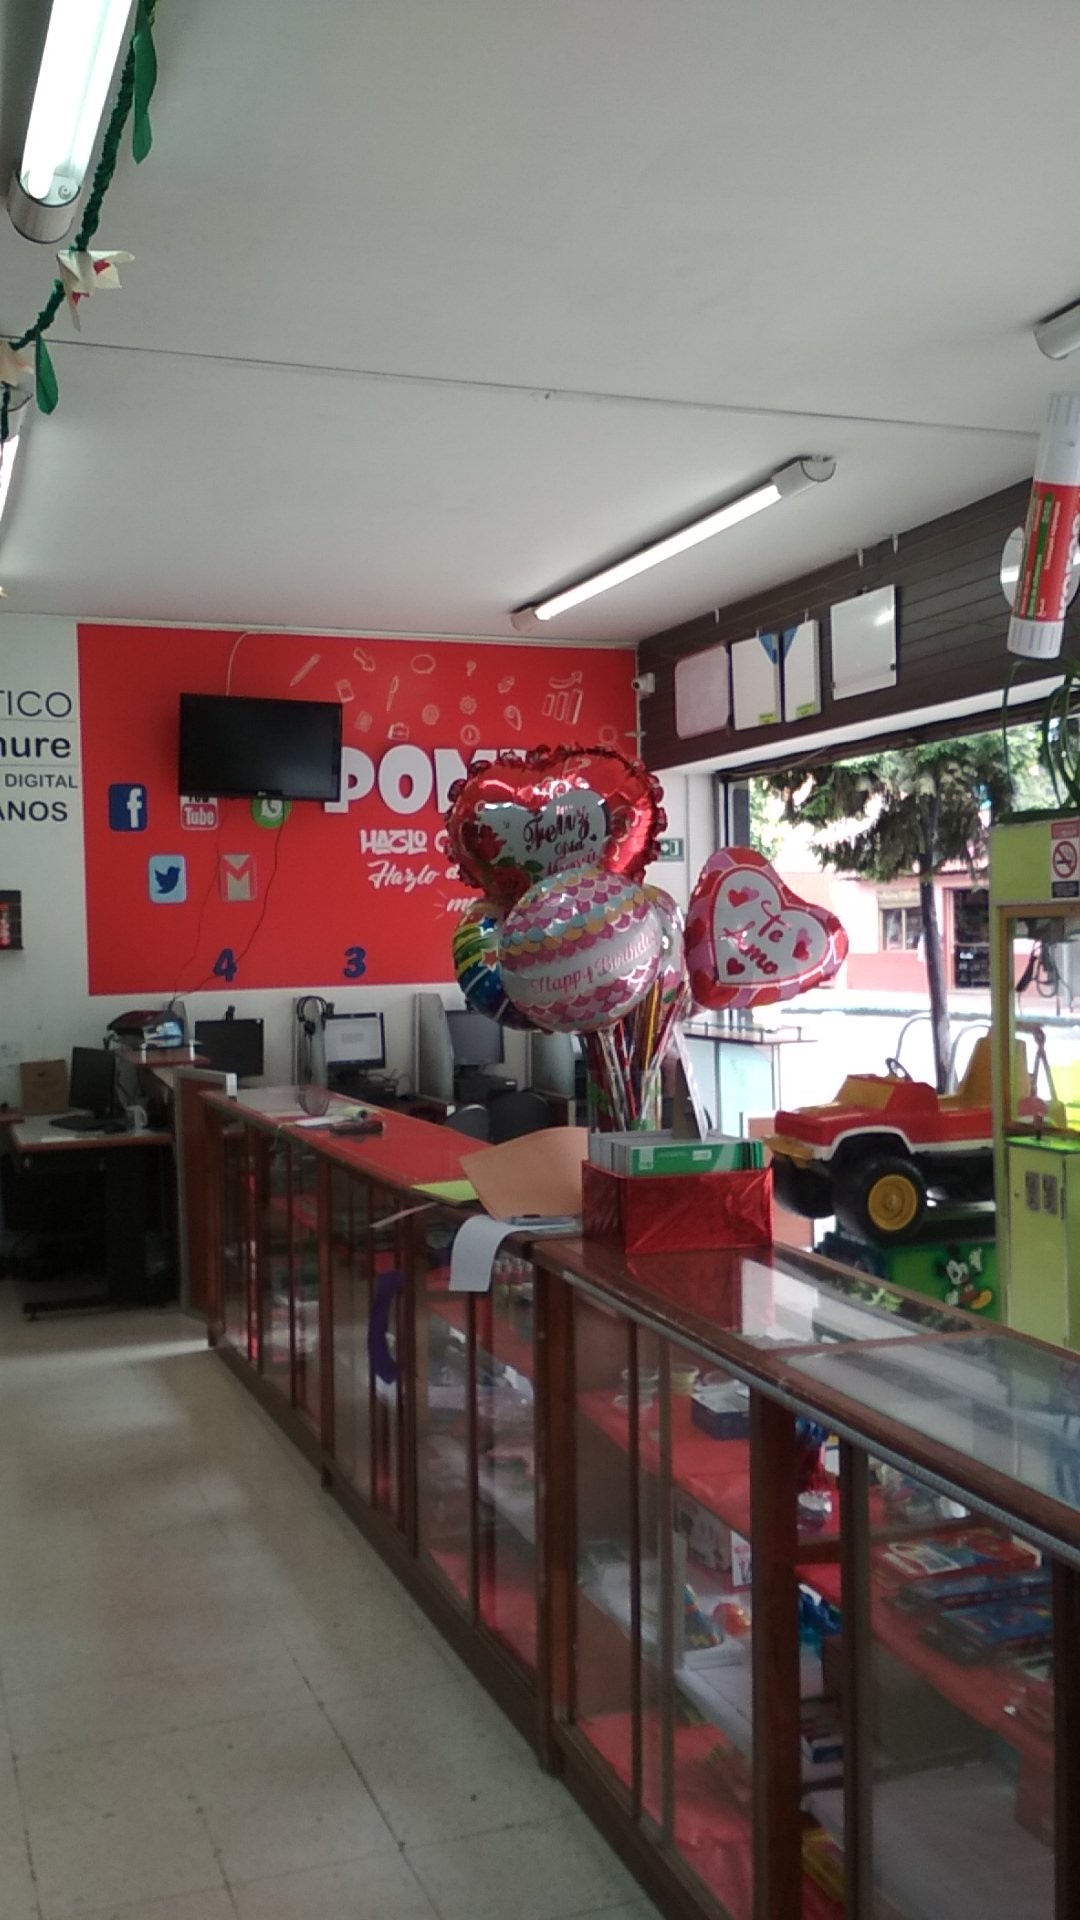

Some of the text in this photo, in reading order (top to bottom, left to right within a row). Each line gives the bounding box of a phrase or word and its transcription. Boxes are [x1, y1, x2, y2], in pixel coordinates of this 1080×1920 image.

[4, 773, 78, 789] DIGITAL
[184, 806, 214, 825] Tube
[367, 860, 440, 893] Hazlo
[758, 900, 793, 943] Te
[343, 946, 367, 978] 3
[720, 920, 779, 975] Amo
[213, 948, 238, 983] 4
[530, 966, 593, 994] Happy
